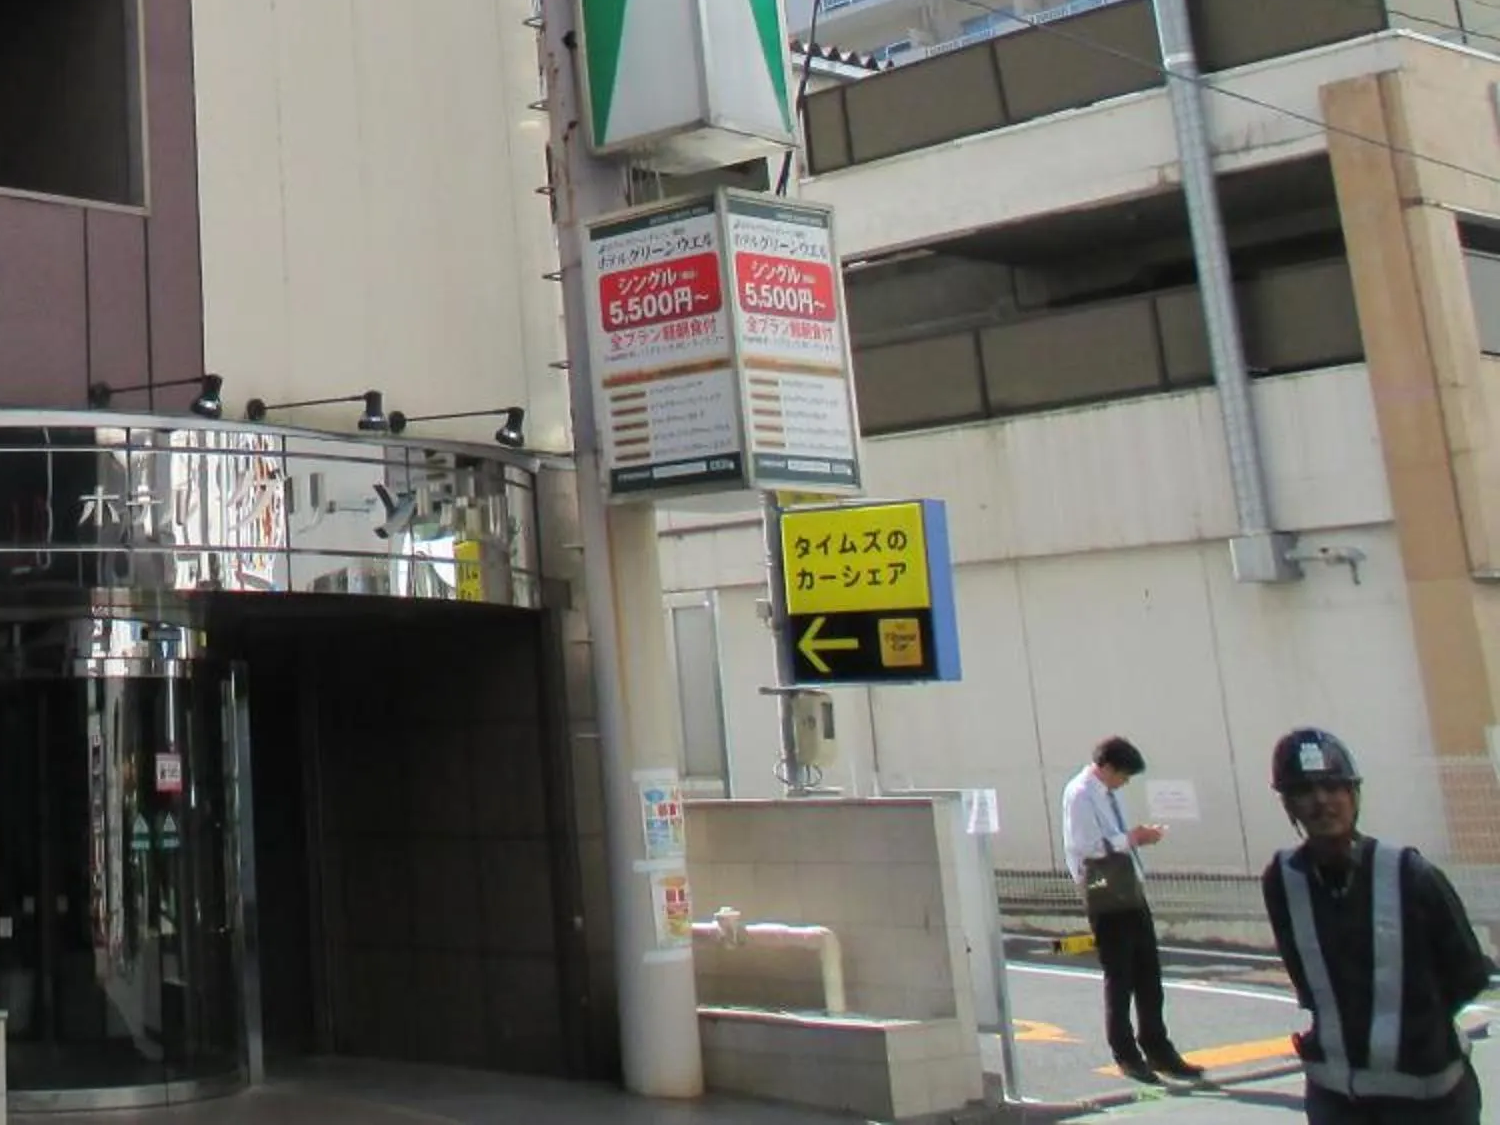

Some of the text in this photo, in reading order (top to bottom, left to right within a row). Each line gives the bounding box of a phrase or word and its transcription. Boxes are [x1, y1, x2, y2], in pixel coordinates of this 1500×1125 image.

[795, 530, 908, 559] タイムズの
[796, 562, 907, 591] カーシェア
